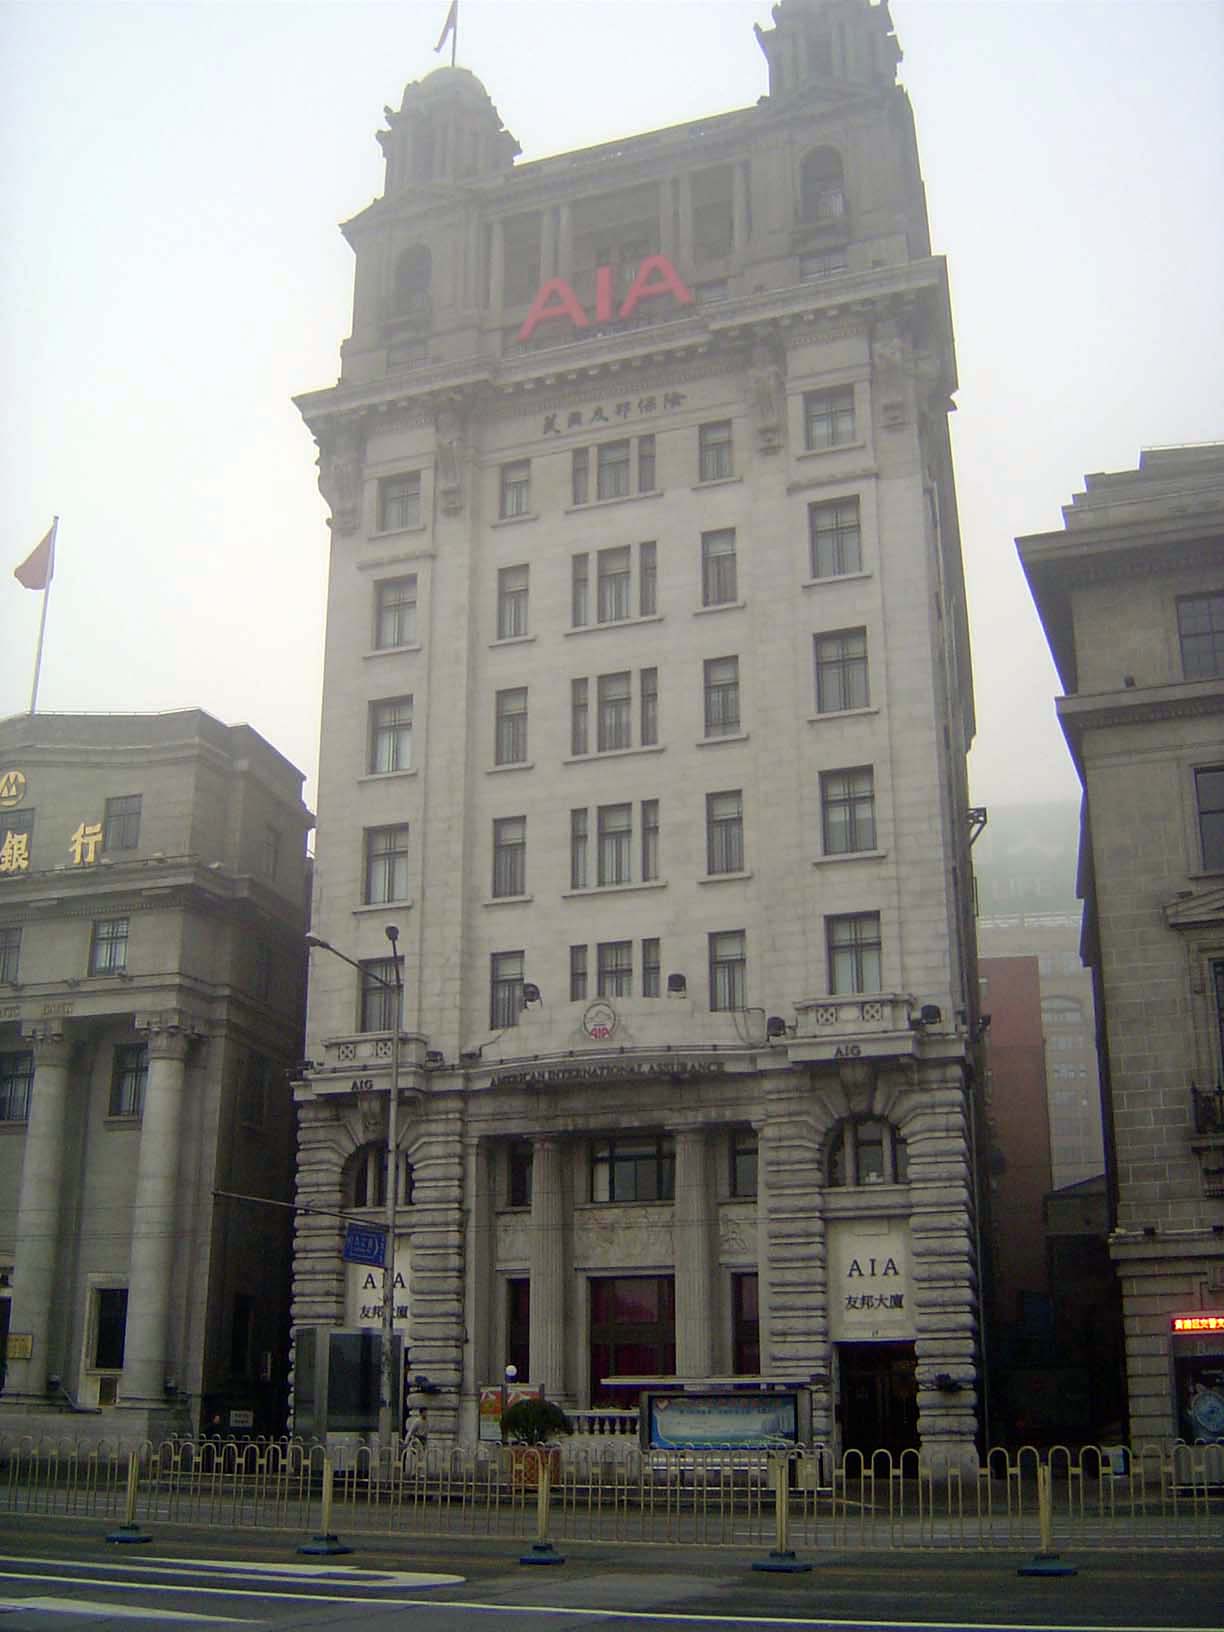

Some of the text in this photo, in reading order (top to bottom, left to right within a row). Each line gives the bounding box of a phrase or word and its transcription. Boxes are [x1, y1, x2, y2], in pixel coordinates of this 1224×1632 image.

[516, 254, 695, 342] AIA
[490, 1062, 725, 1087] AMERICAN INTERNATIONAL ASSURANCE
[848, 1258, 899, 1277] AIA
